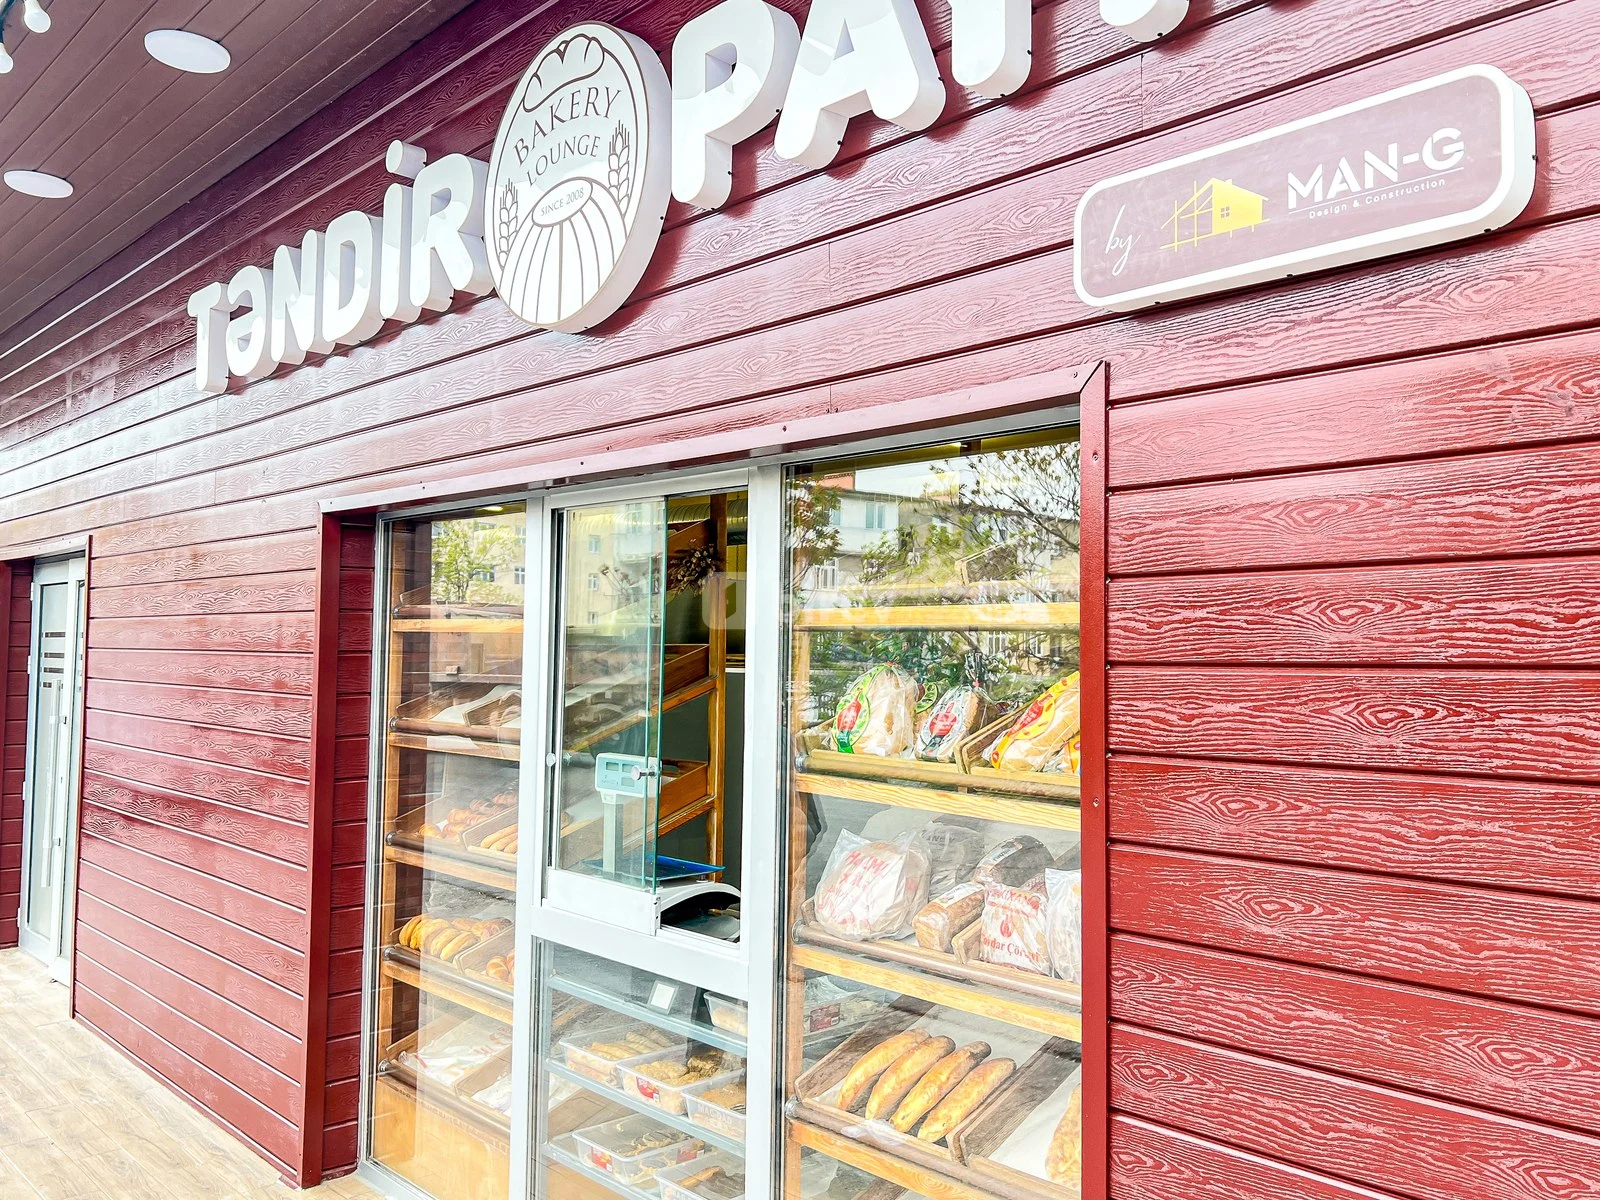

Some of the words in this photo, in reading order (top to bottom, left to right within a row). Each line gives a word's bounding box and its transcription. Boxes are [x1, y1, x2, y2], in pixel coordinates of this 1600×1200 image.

[514, 86, 621, 166] BAKERY
[526, 134, 601, 187] LOUNGE
[540, 198, 564, 217] SINCE
[566, 187, 585, 206] 2008
[1105, 204, 1143, 276] by
[1287, 127, 1465, 210] MAN-G
[1309, 203, 1347, 219] Design
[1353, 198, 1361, 208] &
[1365, 178, 1446, 204] Construction
[188, 139, 490, 393] TƏNDİR
